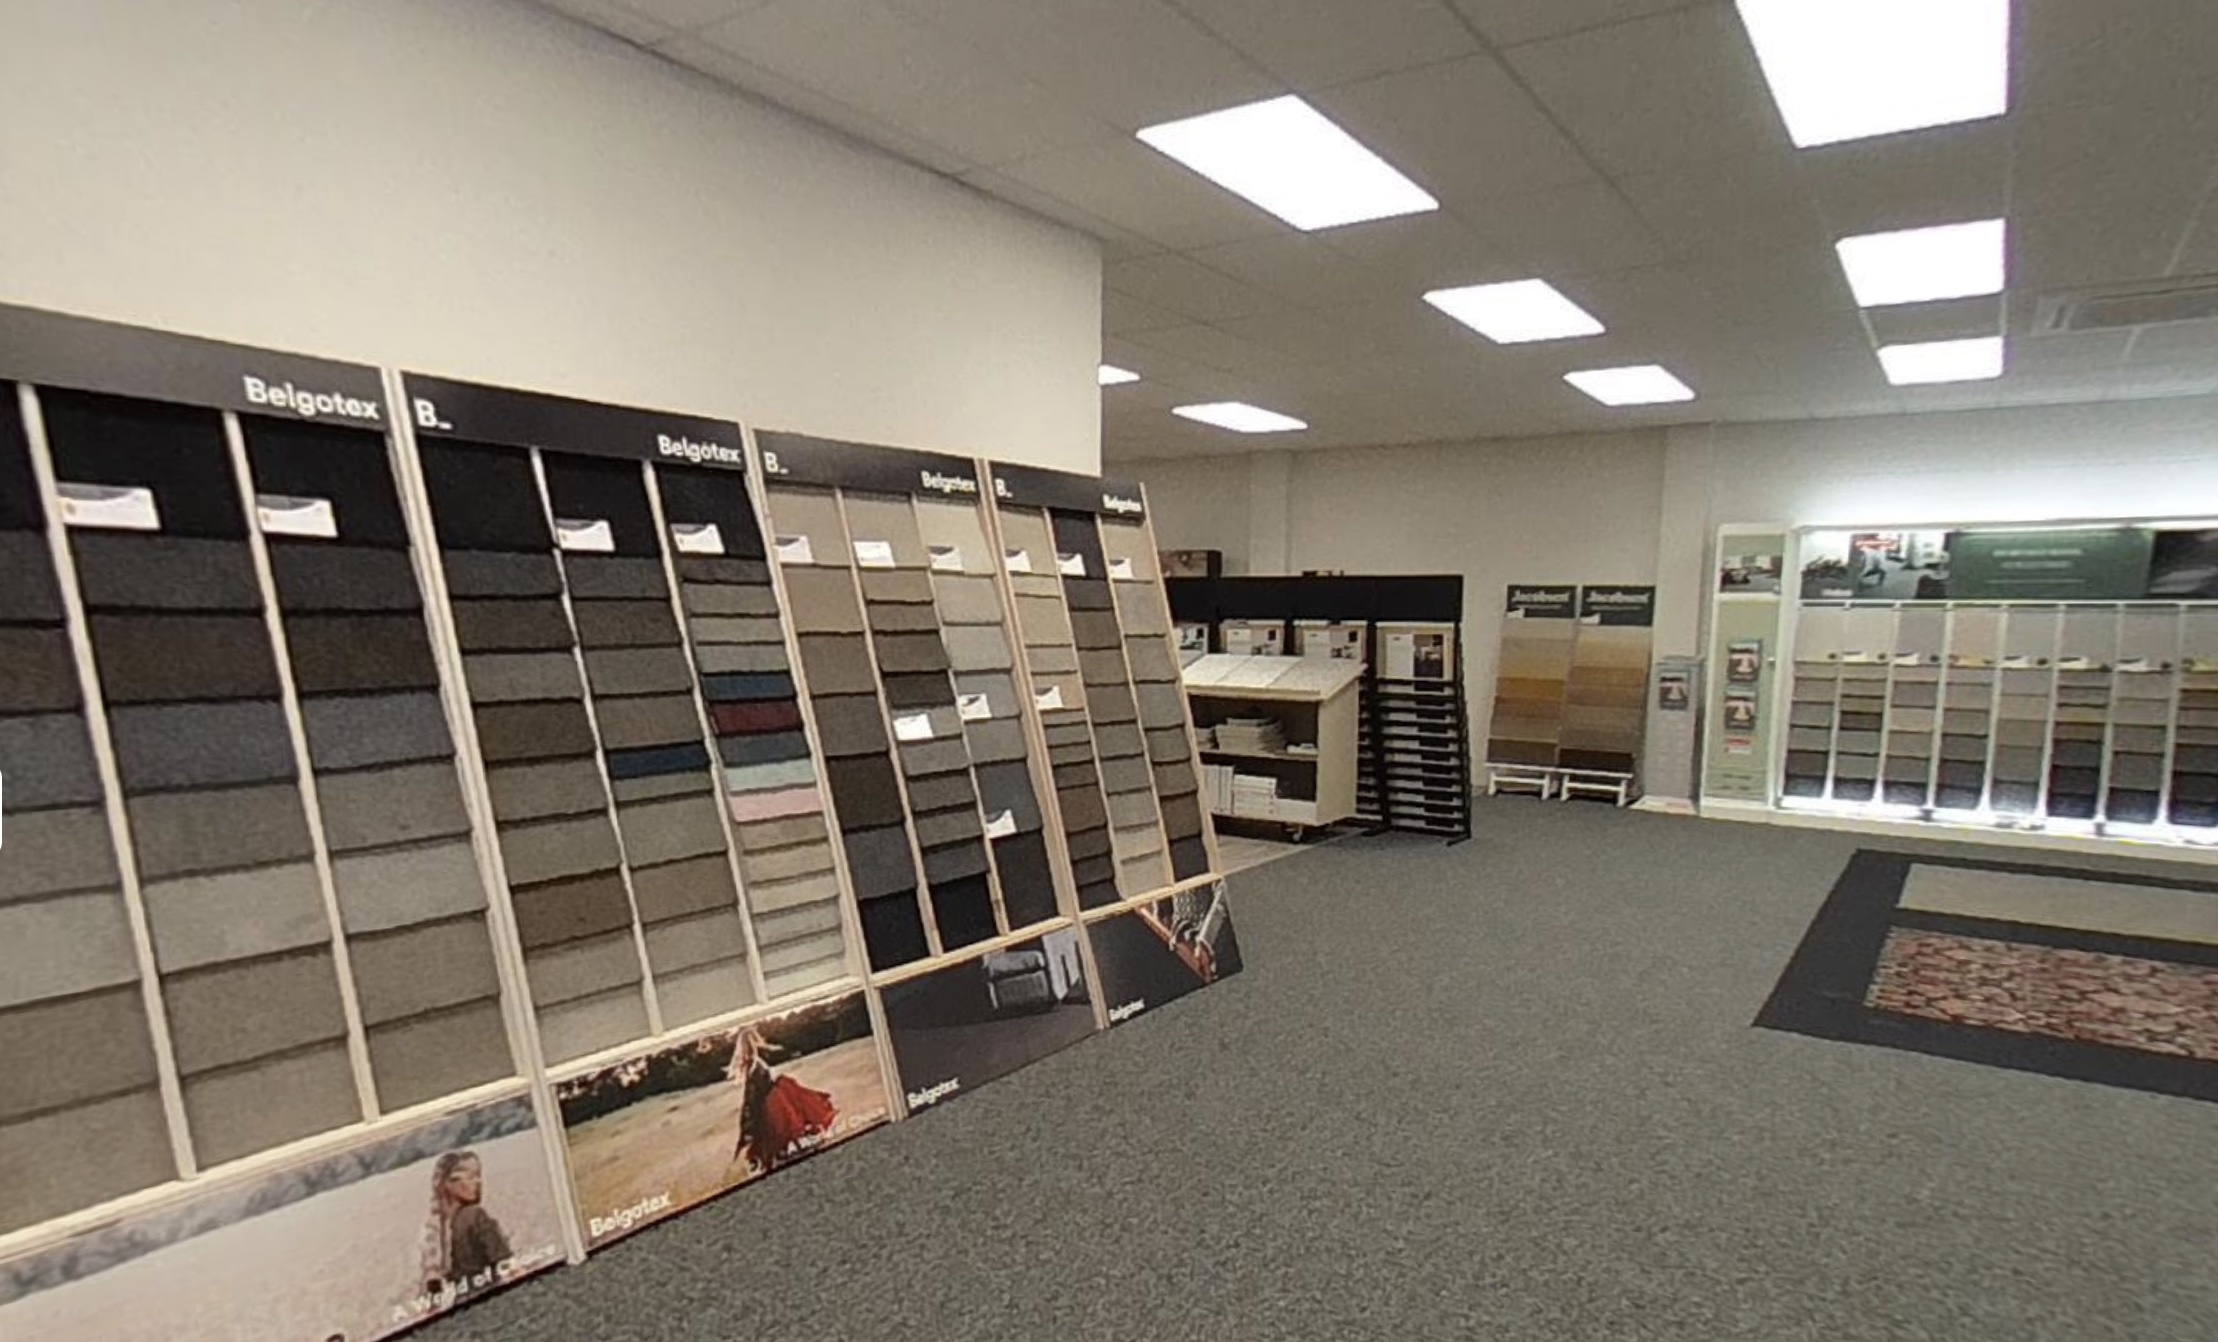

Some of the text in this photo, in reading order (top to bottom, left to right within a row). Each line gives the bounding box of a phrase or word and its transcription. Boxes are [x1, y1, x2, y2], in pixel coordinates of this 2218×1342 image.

[243, 374, 380, 420] Belgotex
[657, 433, 742, 464] Belgotex
[590, 1191, 672, 1238] Belgotex
